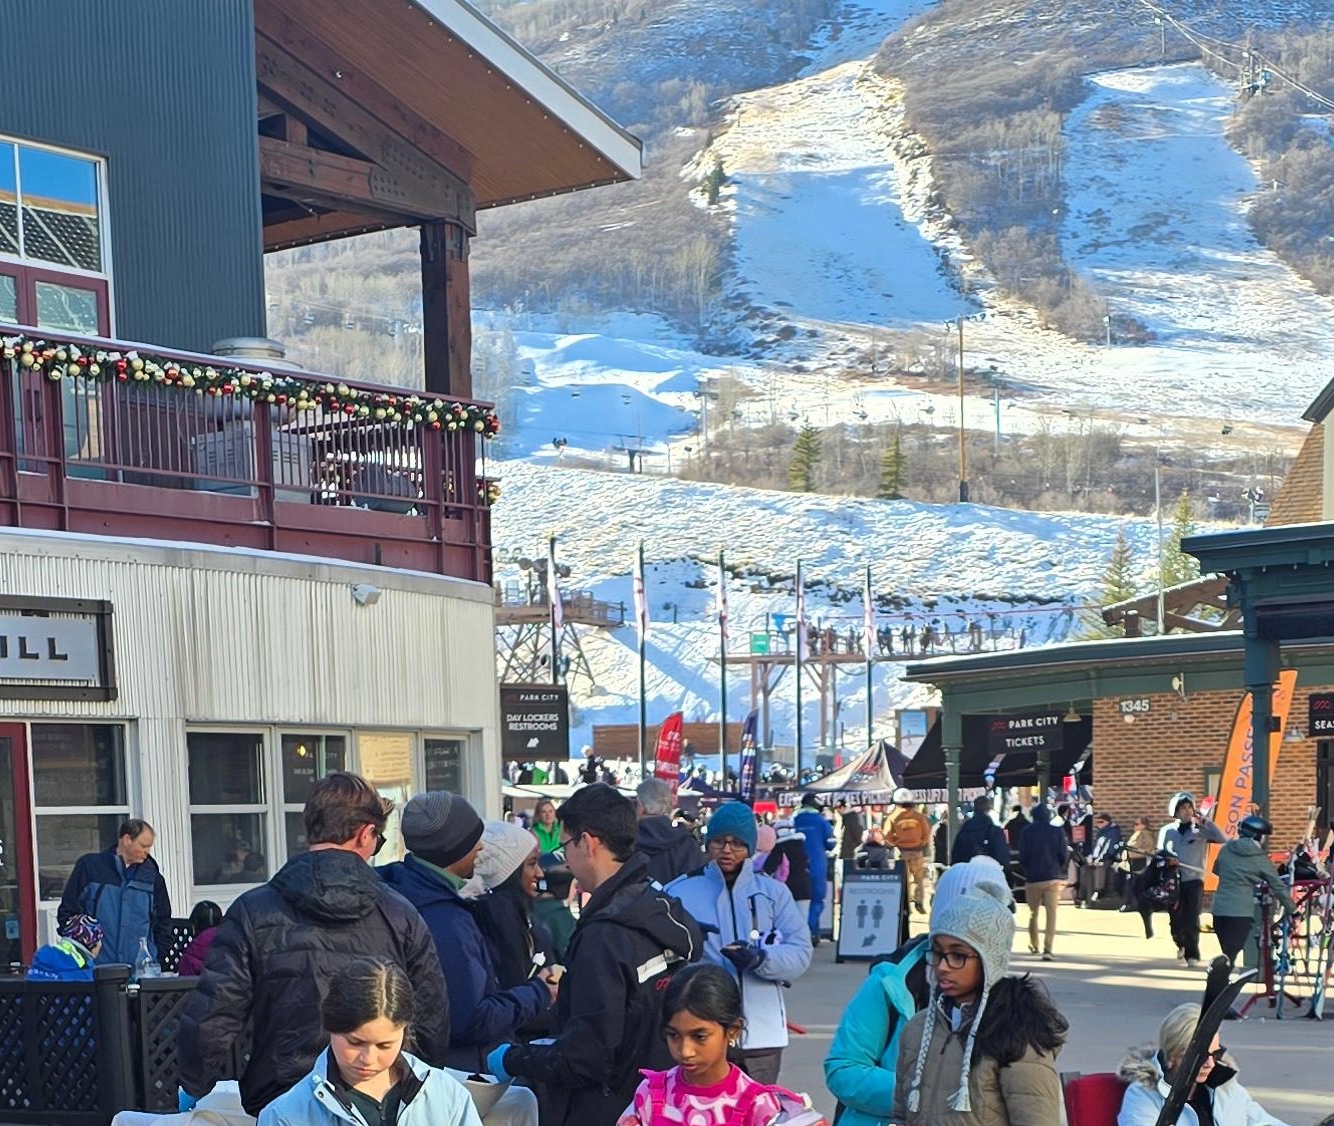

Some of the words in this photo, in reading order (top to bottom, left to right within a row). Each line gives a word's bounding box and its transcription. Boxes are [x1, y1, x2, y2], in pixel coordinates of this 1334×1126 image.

[1120, 699, 1150, 712] 1345
[507, 713, 522, 721] DAY
[522, 713, 559, 721] LOCKERS
[1008, 718, 1034, 729] PARK
[1036, 716, 1059, 727] CITY
[508, 722, 558, 731] RESTROOMS
[1005, 735, 1045, 747] TICKETS
